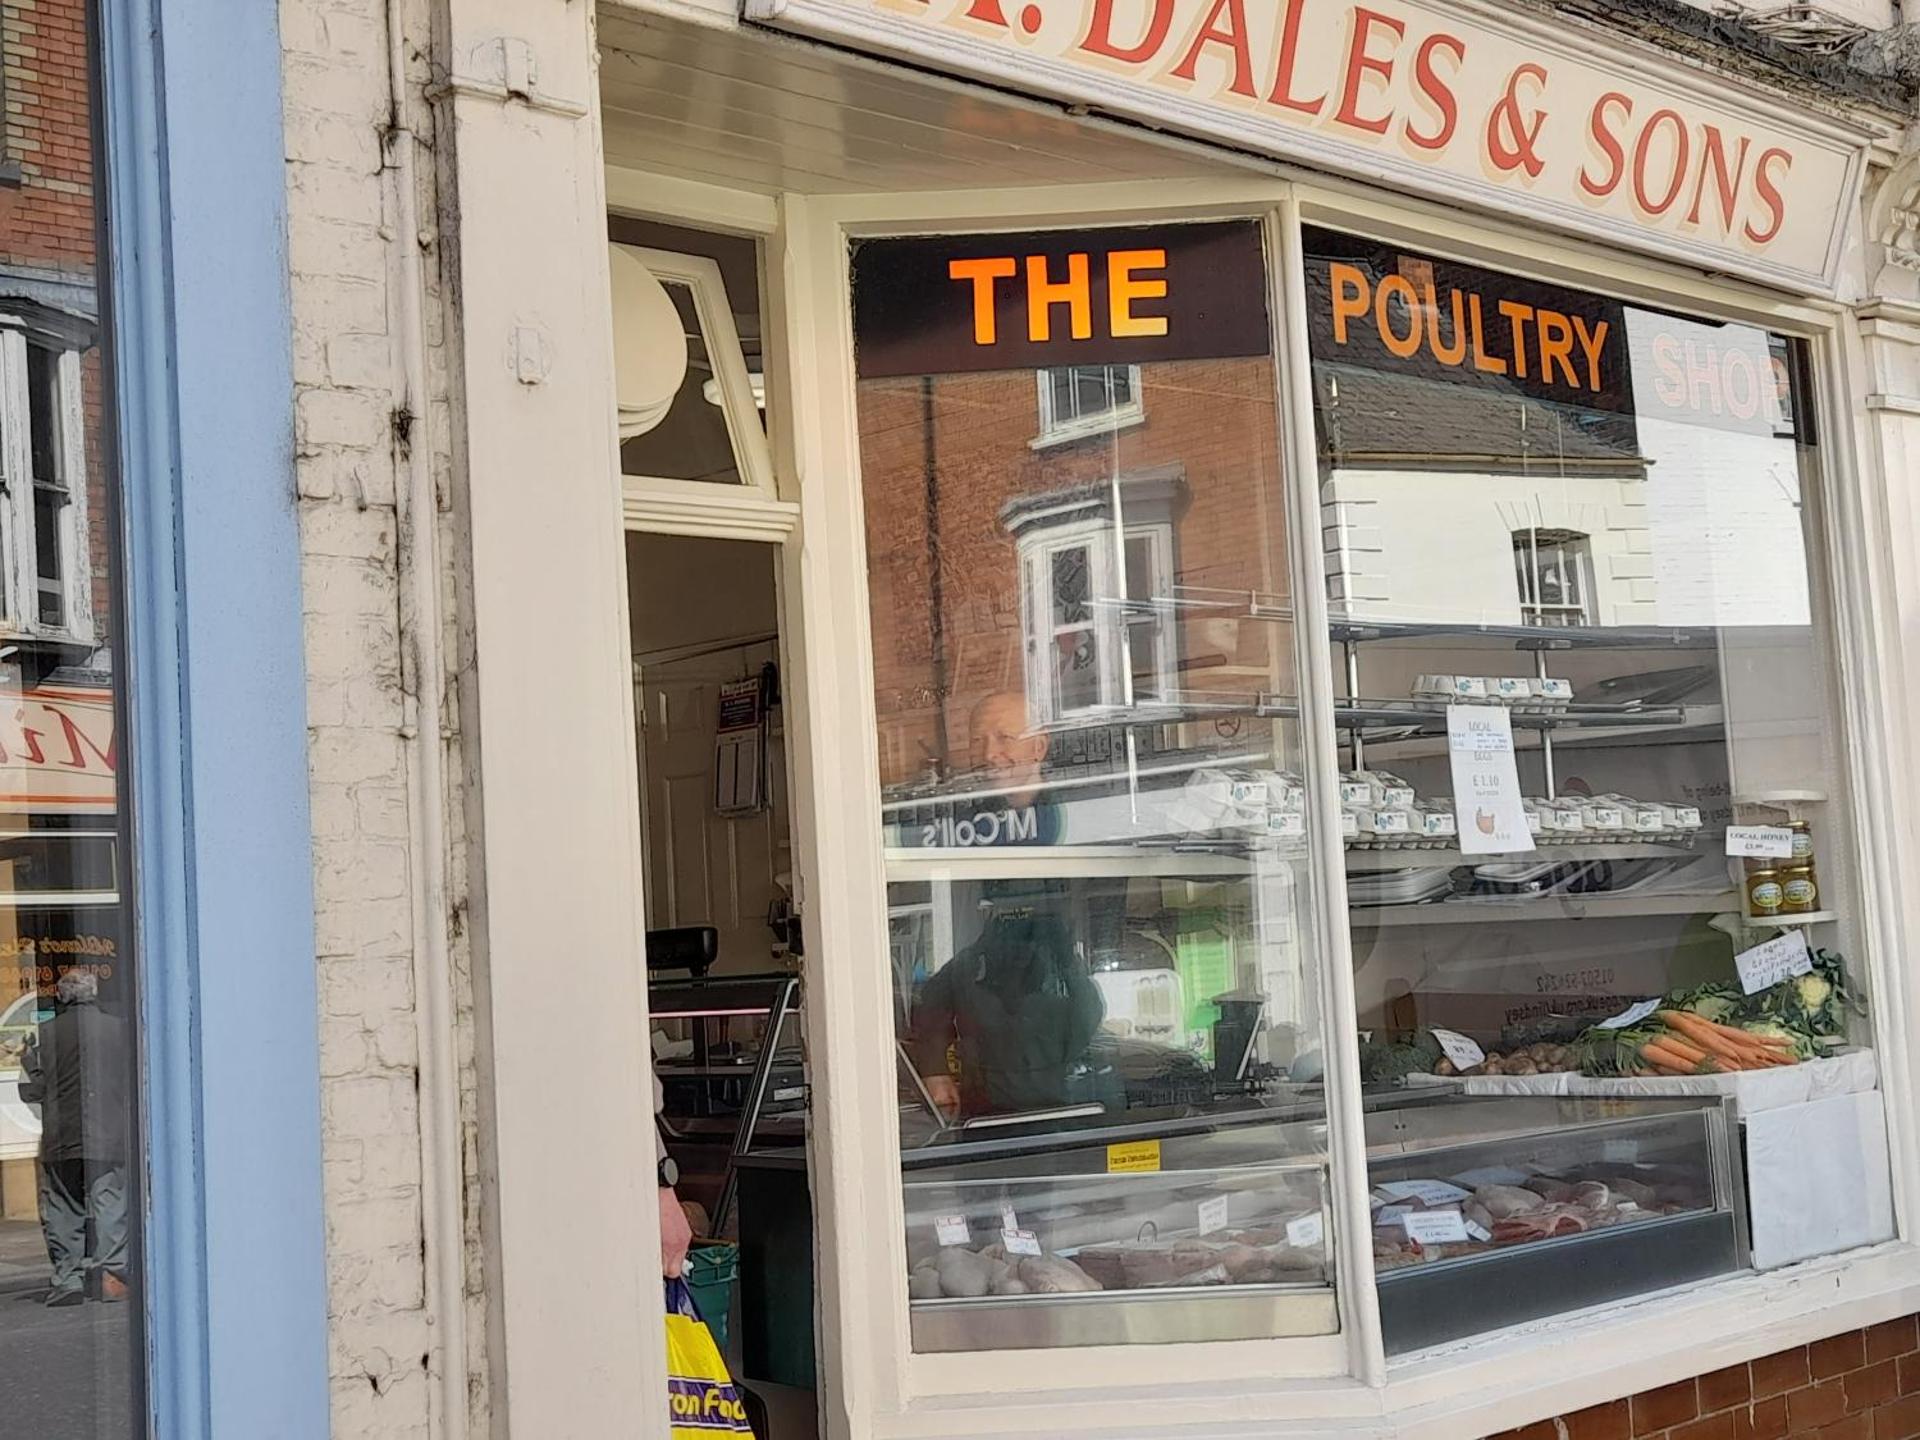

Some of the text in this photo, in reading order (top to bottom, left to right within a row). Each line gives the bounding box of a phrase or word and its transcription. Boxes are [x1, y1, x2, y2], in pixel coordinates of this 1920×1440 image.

[1486, 63, 1548, 178] &
[1580, 92, 1793, 244] SONS
[949, 249, 1791, 420] THE POULTRY SHOP
